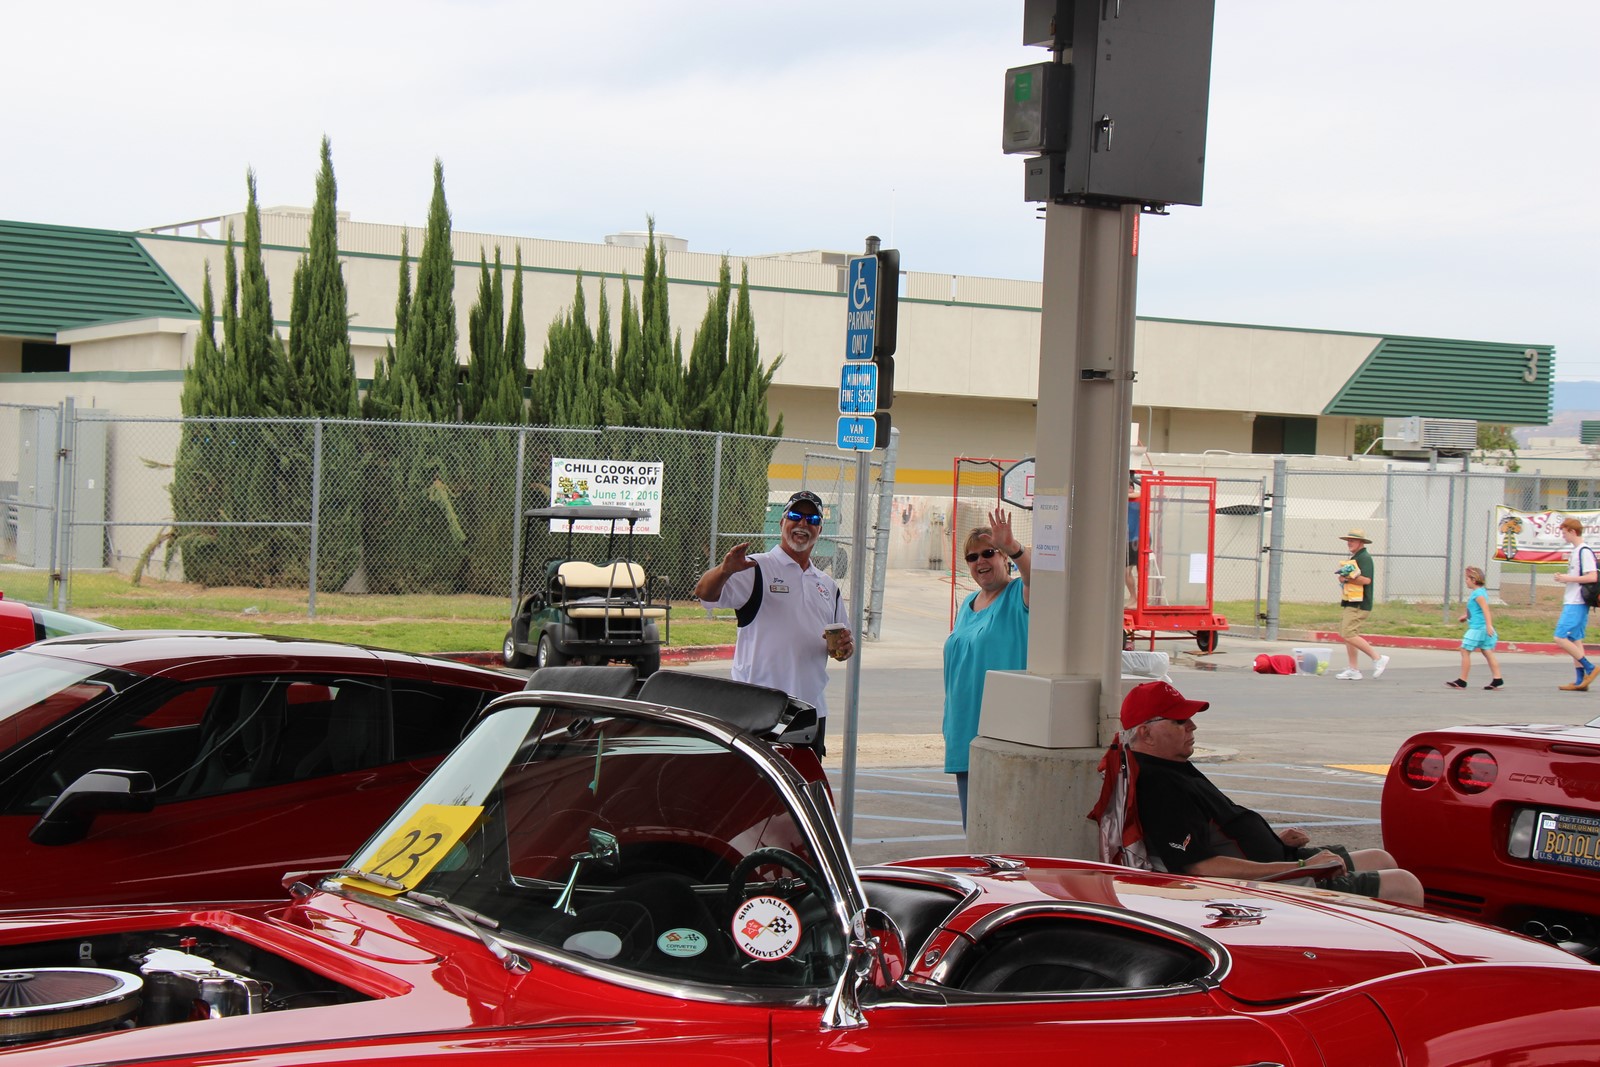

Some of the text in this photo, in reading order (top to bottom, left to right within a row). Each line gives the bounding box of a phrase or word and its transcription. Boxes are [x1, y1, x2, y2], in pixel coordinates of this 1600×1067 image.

[848, 311, 874, 330] PARKING
[851, 334, 868, 354] ONLY
[1524, 348, 1539, 384] 3
[846, 372, 870, 386] MINIMUM
[842, 389, 854, 402] FINE
[850, 424, 864, 434] VAN
[843, 435, 869, 444] ACCESSIBLE
[565, 463, 597, 473] CHILI
[601, 465, 634, 474] COOK
[639, 466, 660, 475] OFF
[595, 475, 657, 485] CAR SHOW
[592, 489, 617, 499] June
[637, 491, 658, 500] 2016
[1558, 822, 1600, 833] CALIFORNIA
[369, 830, 442, 882] 23
[1540, 852, 1555, 860] U.S.
[1575, 858, 1600, 867] FORC
[738, 898, 792, 920] SIMI VALLEY
[744, 939, 793, 958] CORVETTES
